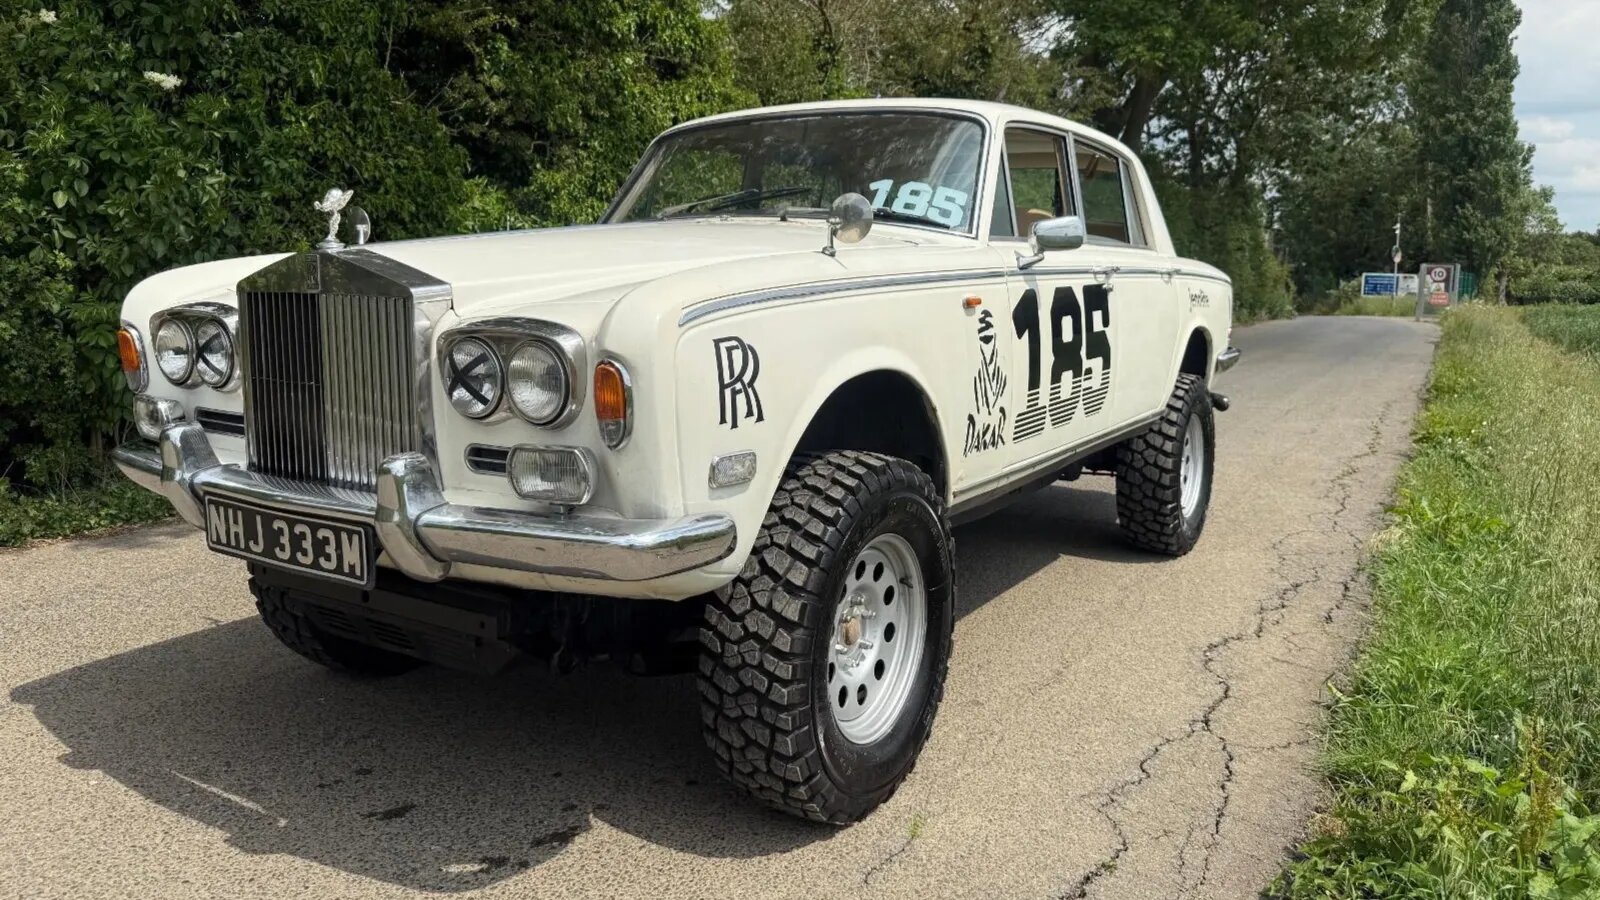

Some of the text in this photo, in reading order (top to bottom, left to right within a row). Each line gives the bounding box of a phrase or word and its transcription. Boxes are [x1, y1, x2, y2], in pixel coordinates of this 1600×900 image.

[869, 179, 967, 228] 185
[1434, 270, 1444, 278] 10
[1012, 284, 1111, 444] 185
[963, 406, 1006, 458] DAKAR
[208, 504, 362, 577] NHJ 333M
